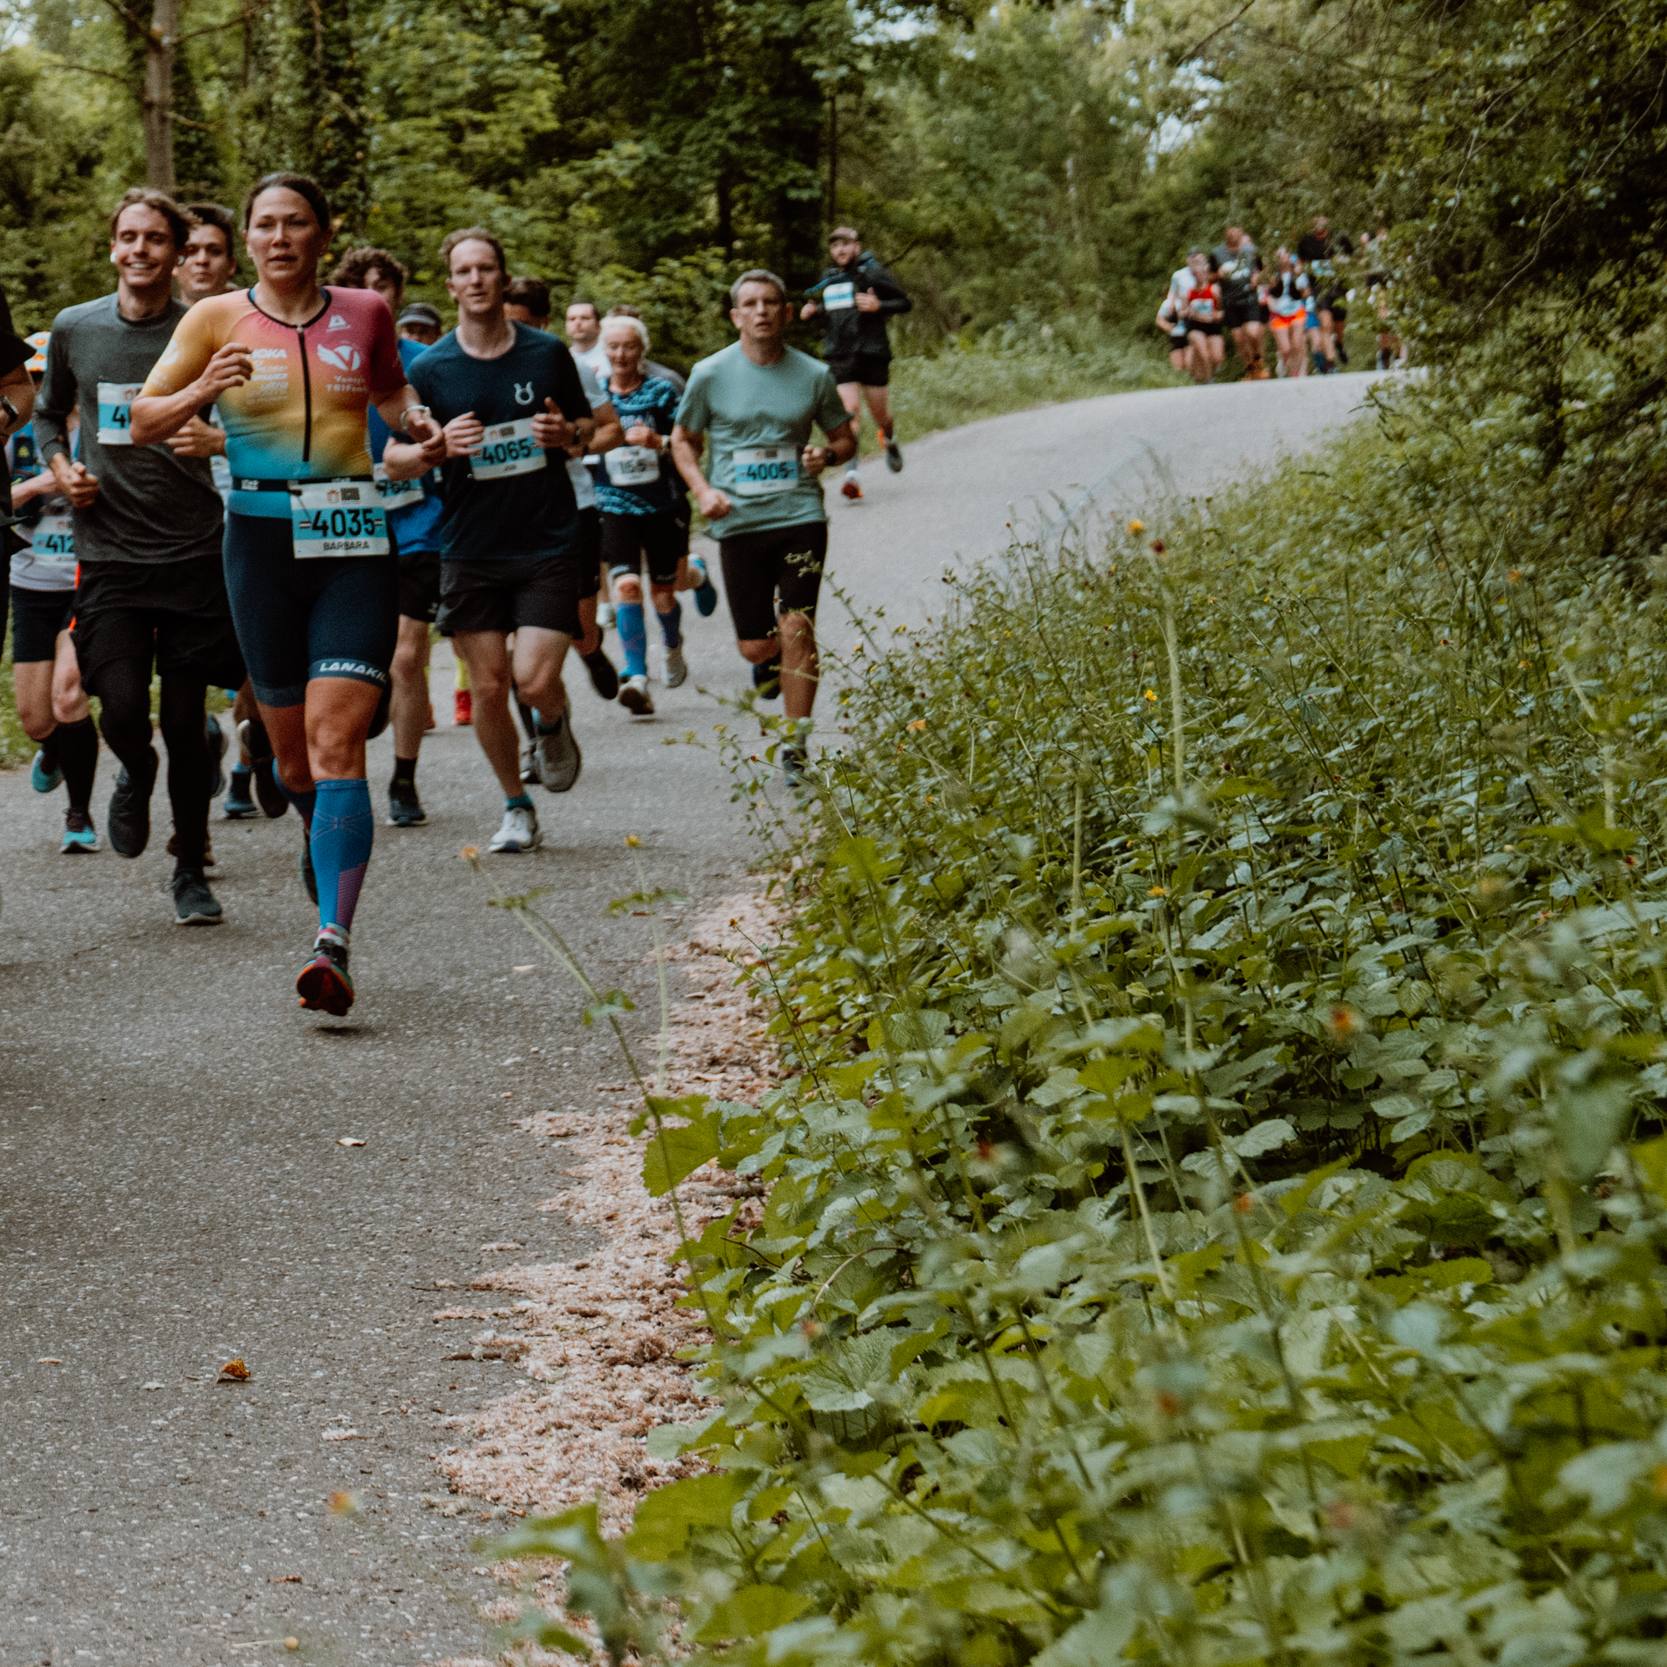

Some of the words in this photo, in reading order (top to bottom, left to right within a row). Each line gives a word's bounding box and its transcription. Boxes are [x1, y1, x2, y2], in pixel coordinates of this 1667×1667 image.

[482, 438, 531, 464] 4065
[747, 461, 789, 480] 4005
[312, 508, 375, 537] 4035
[323, 541, 370, 550] BARBARA
